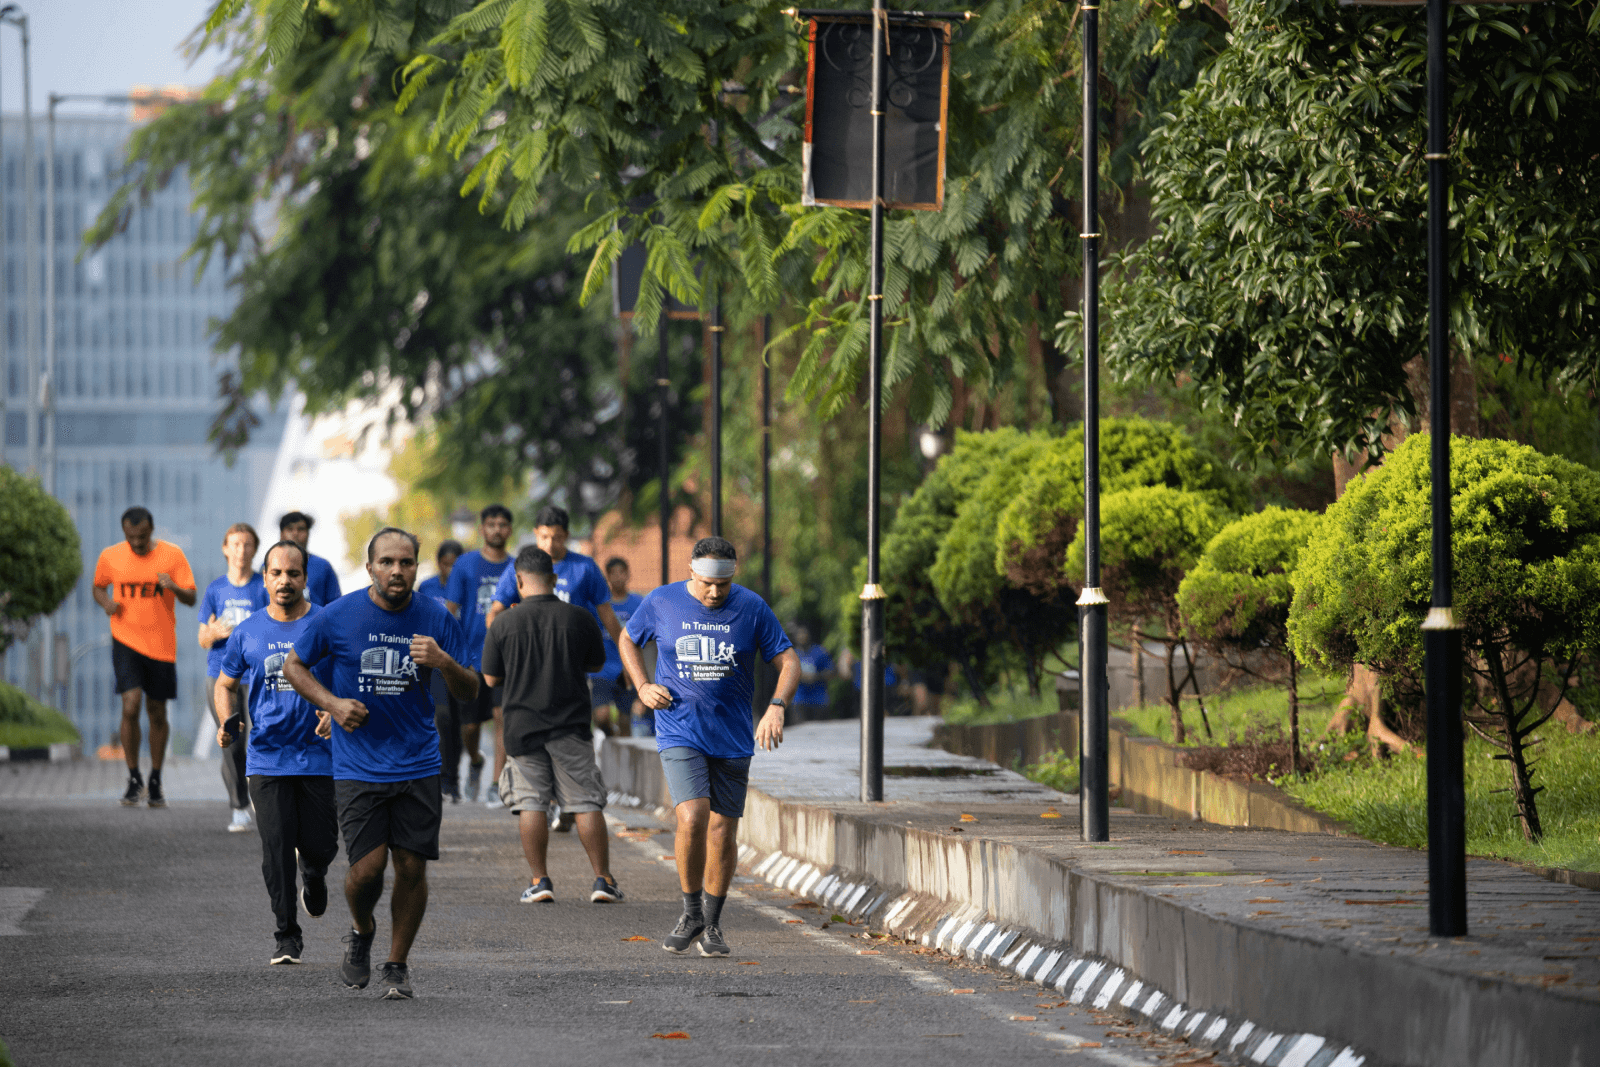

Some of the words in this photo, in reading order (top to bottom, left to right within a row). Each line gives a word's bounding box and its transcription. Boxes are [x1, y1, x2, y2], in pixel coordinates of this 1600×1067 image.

[682, 621, 691, 630] In
[693, 621, 730, 633] Training
[368, 633, 378, 642] In
[268, 642, 276, 650] In
